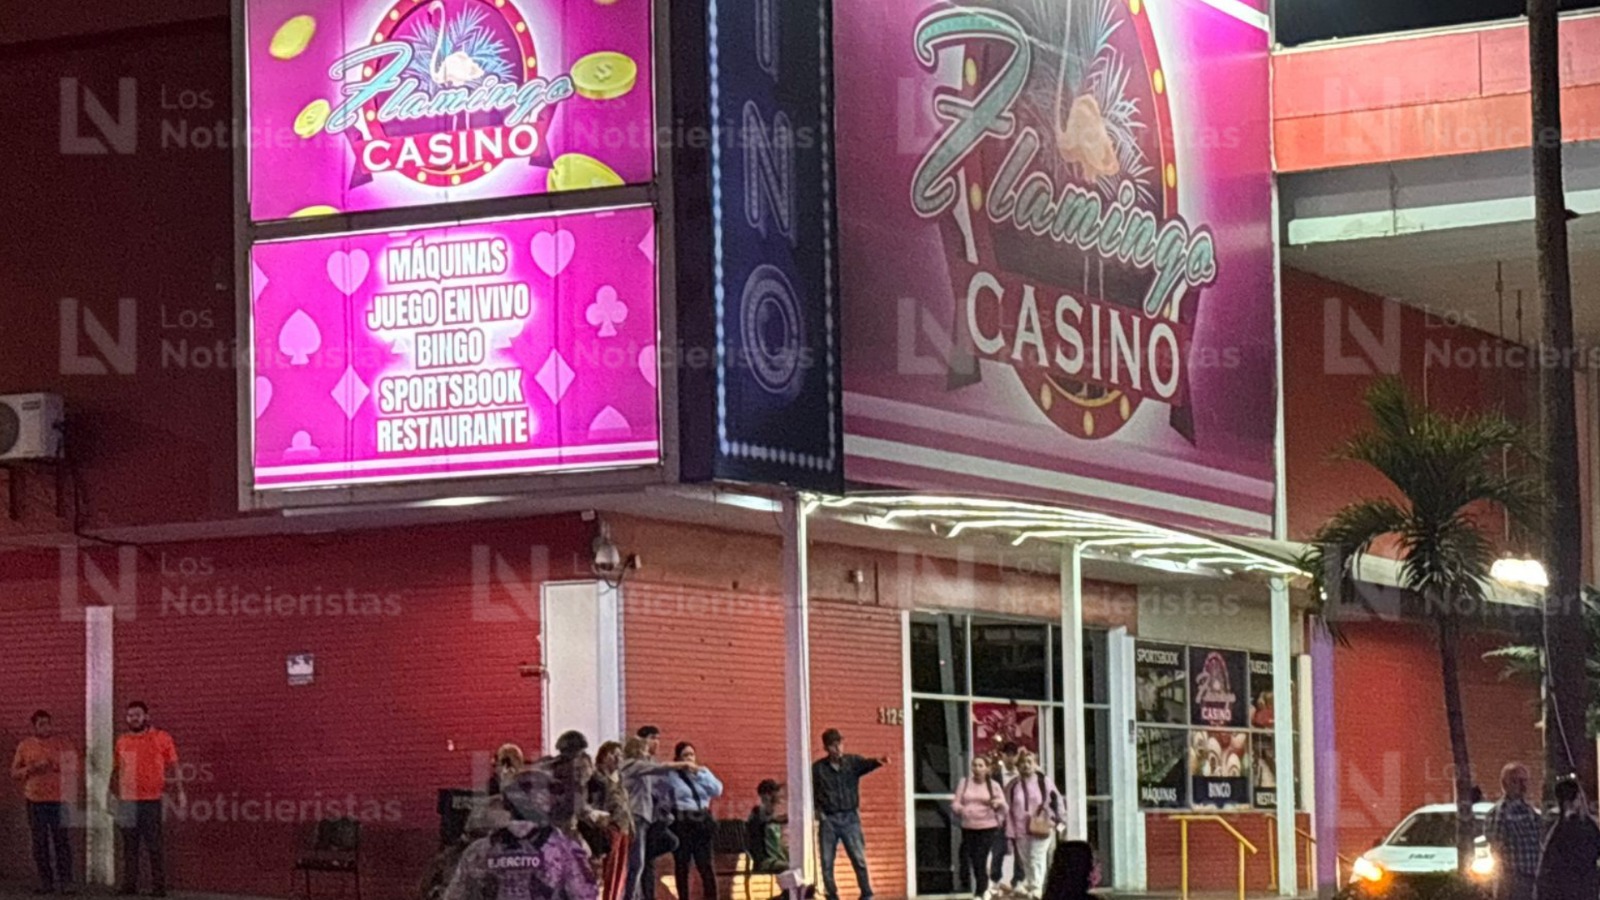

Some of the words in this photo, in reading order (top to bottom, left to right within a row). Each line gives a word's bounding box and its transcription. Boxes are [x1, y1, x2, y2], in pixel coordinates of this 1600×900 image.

[327, 41, 575, 134] Flamingo
[363, 124, 539, 171] CASINO
[911, 7, 1216, 318] Flamingo
[388, 238, 507, 284] MÁQUINAS
[367, 289, 438, 329] JUEGO
[443, 288, 472, 324] EN
[476, 282, 530, 321] VIVO
[416, 329, 484, 368] BINGO
[966, 271, 1180, 398] CASINO
[380, 369, 523, 413] SPORTSBOOK
[377, 409, 528, 452] RESTAURANTE
[1136, 649, 1179, 665] SPORTSBOOK
[1201, 706, 1232, 721] CASINO
[1207, 782, 1232, 798] BINGO
[487, 856, 541, 869] EJERCITO
